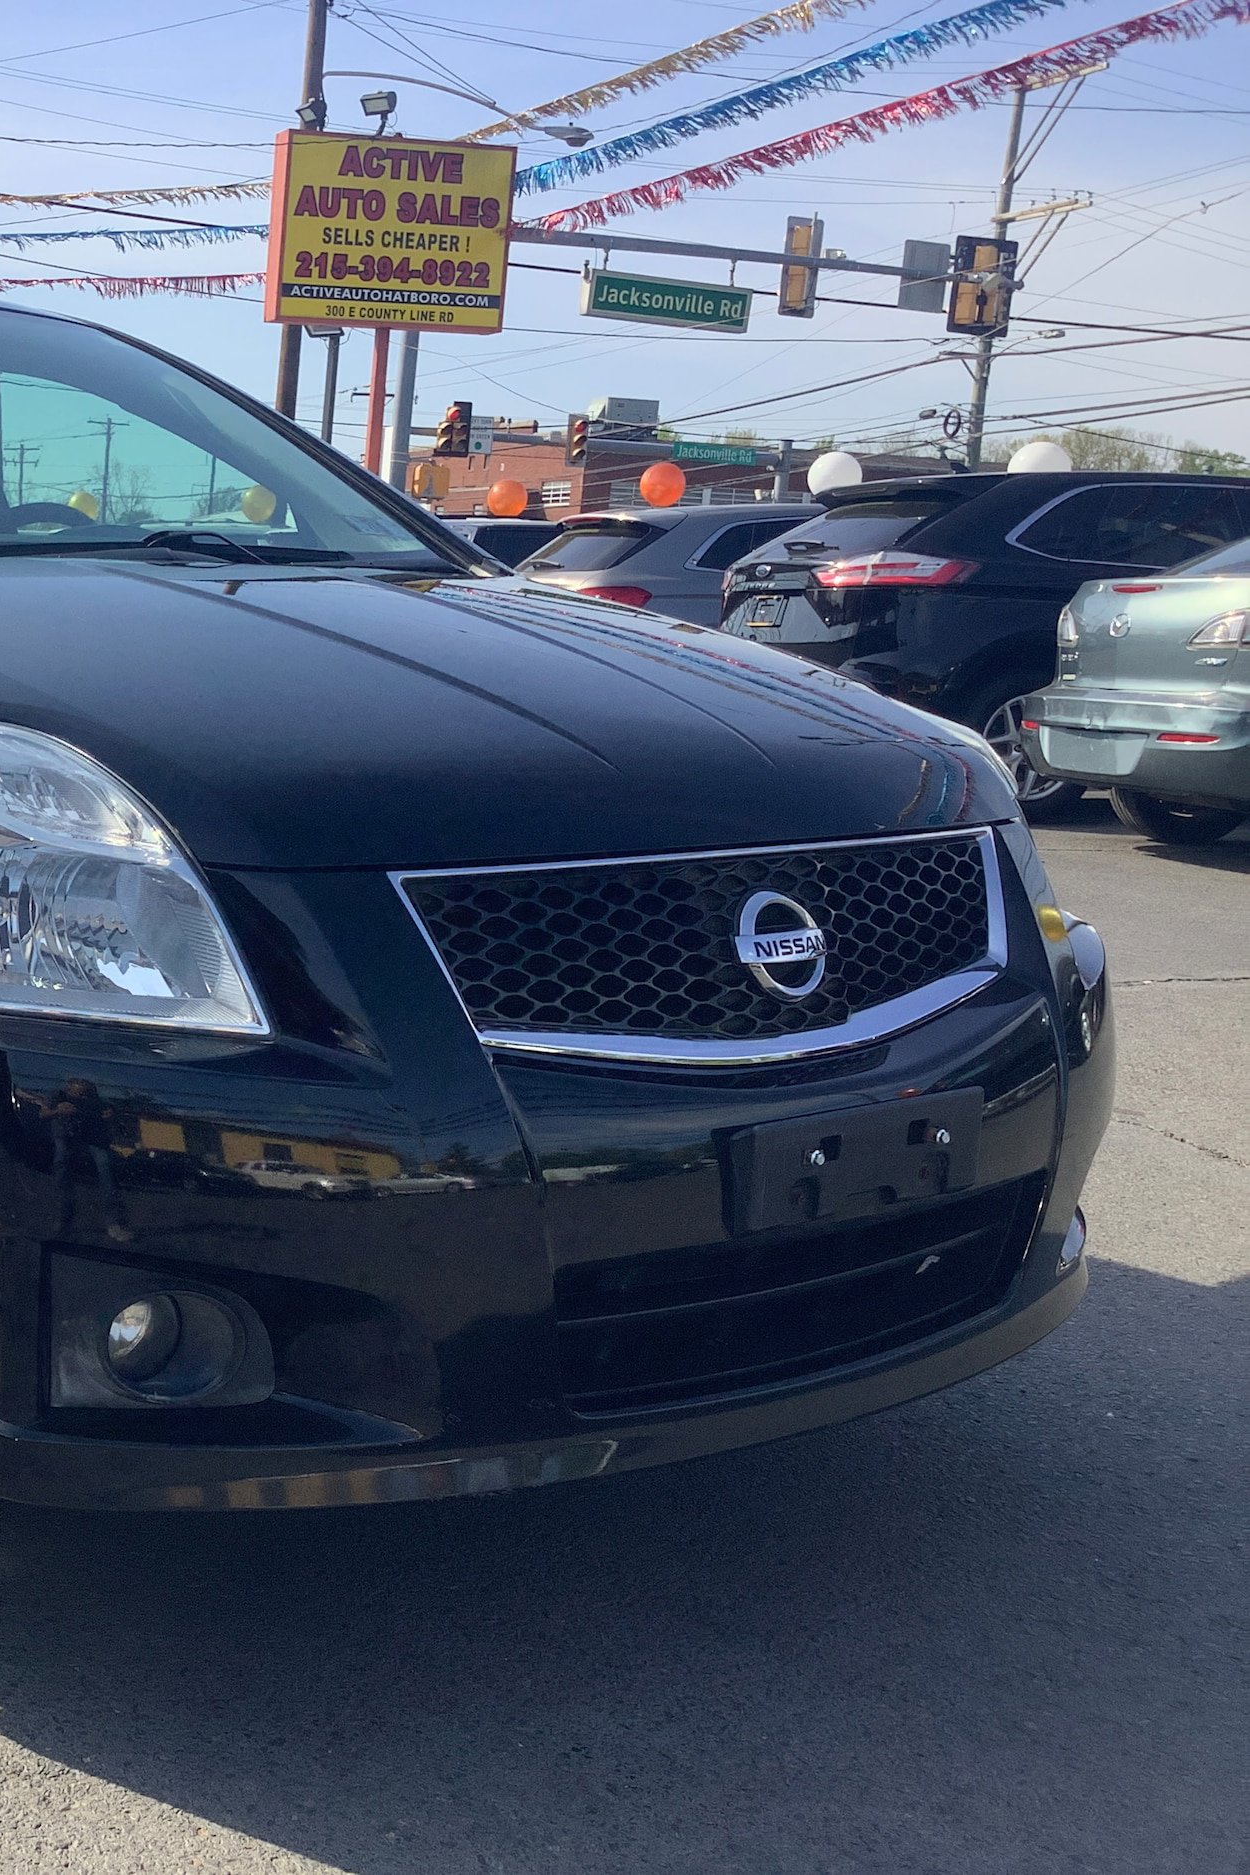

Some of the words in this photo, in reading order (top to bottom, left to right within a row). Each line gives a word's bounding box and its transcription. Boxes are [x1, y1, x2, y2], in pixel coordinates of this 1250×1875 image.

[338, 145, 464, 184] ACTIVE
[294, 185, 386, 221] AUTO
[396, 192, 500, 229] SALES
[322, 227, 375, 247] SELLS
[381, 230, 459, 252] CHEAPER
[294, 251, 490, 288] 215-394-8922
[290, 285, 489, 307] ACTIVEAUTOHATBORO.COM
[598, 284, 714, 315] Jacksonville
[719, 299, 743, 318] Rd
[325, 306, 345, 317] 300
[349, 307, 355, 317] E
[359, 307, 406, 320] COUNTY
[410, 309, 435, 322] LINE
[439, 311, 454, 323] RD
[677, 445, 737, 461] Jacksonville
[739, 450, 752, 463] Rd
[754, 934, 825, 957] NISSAN
